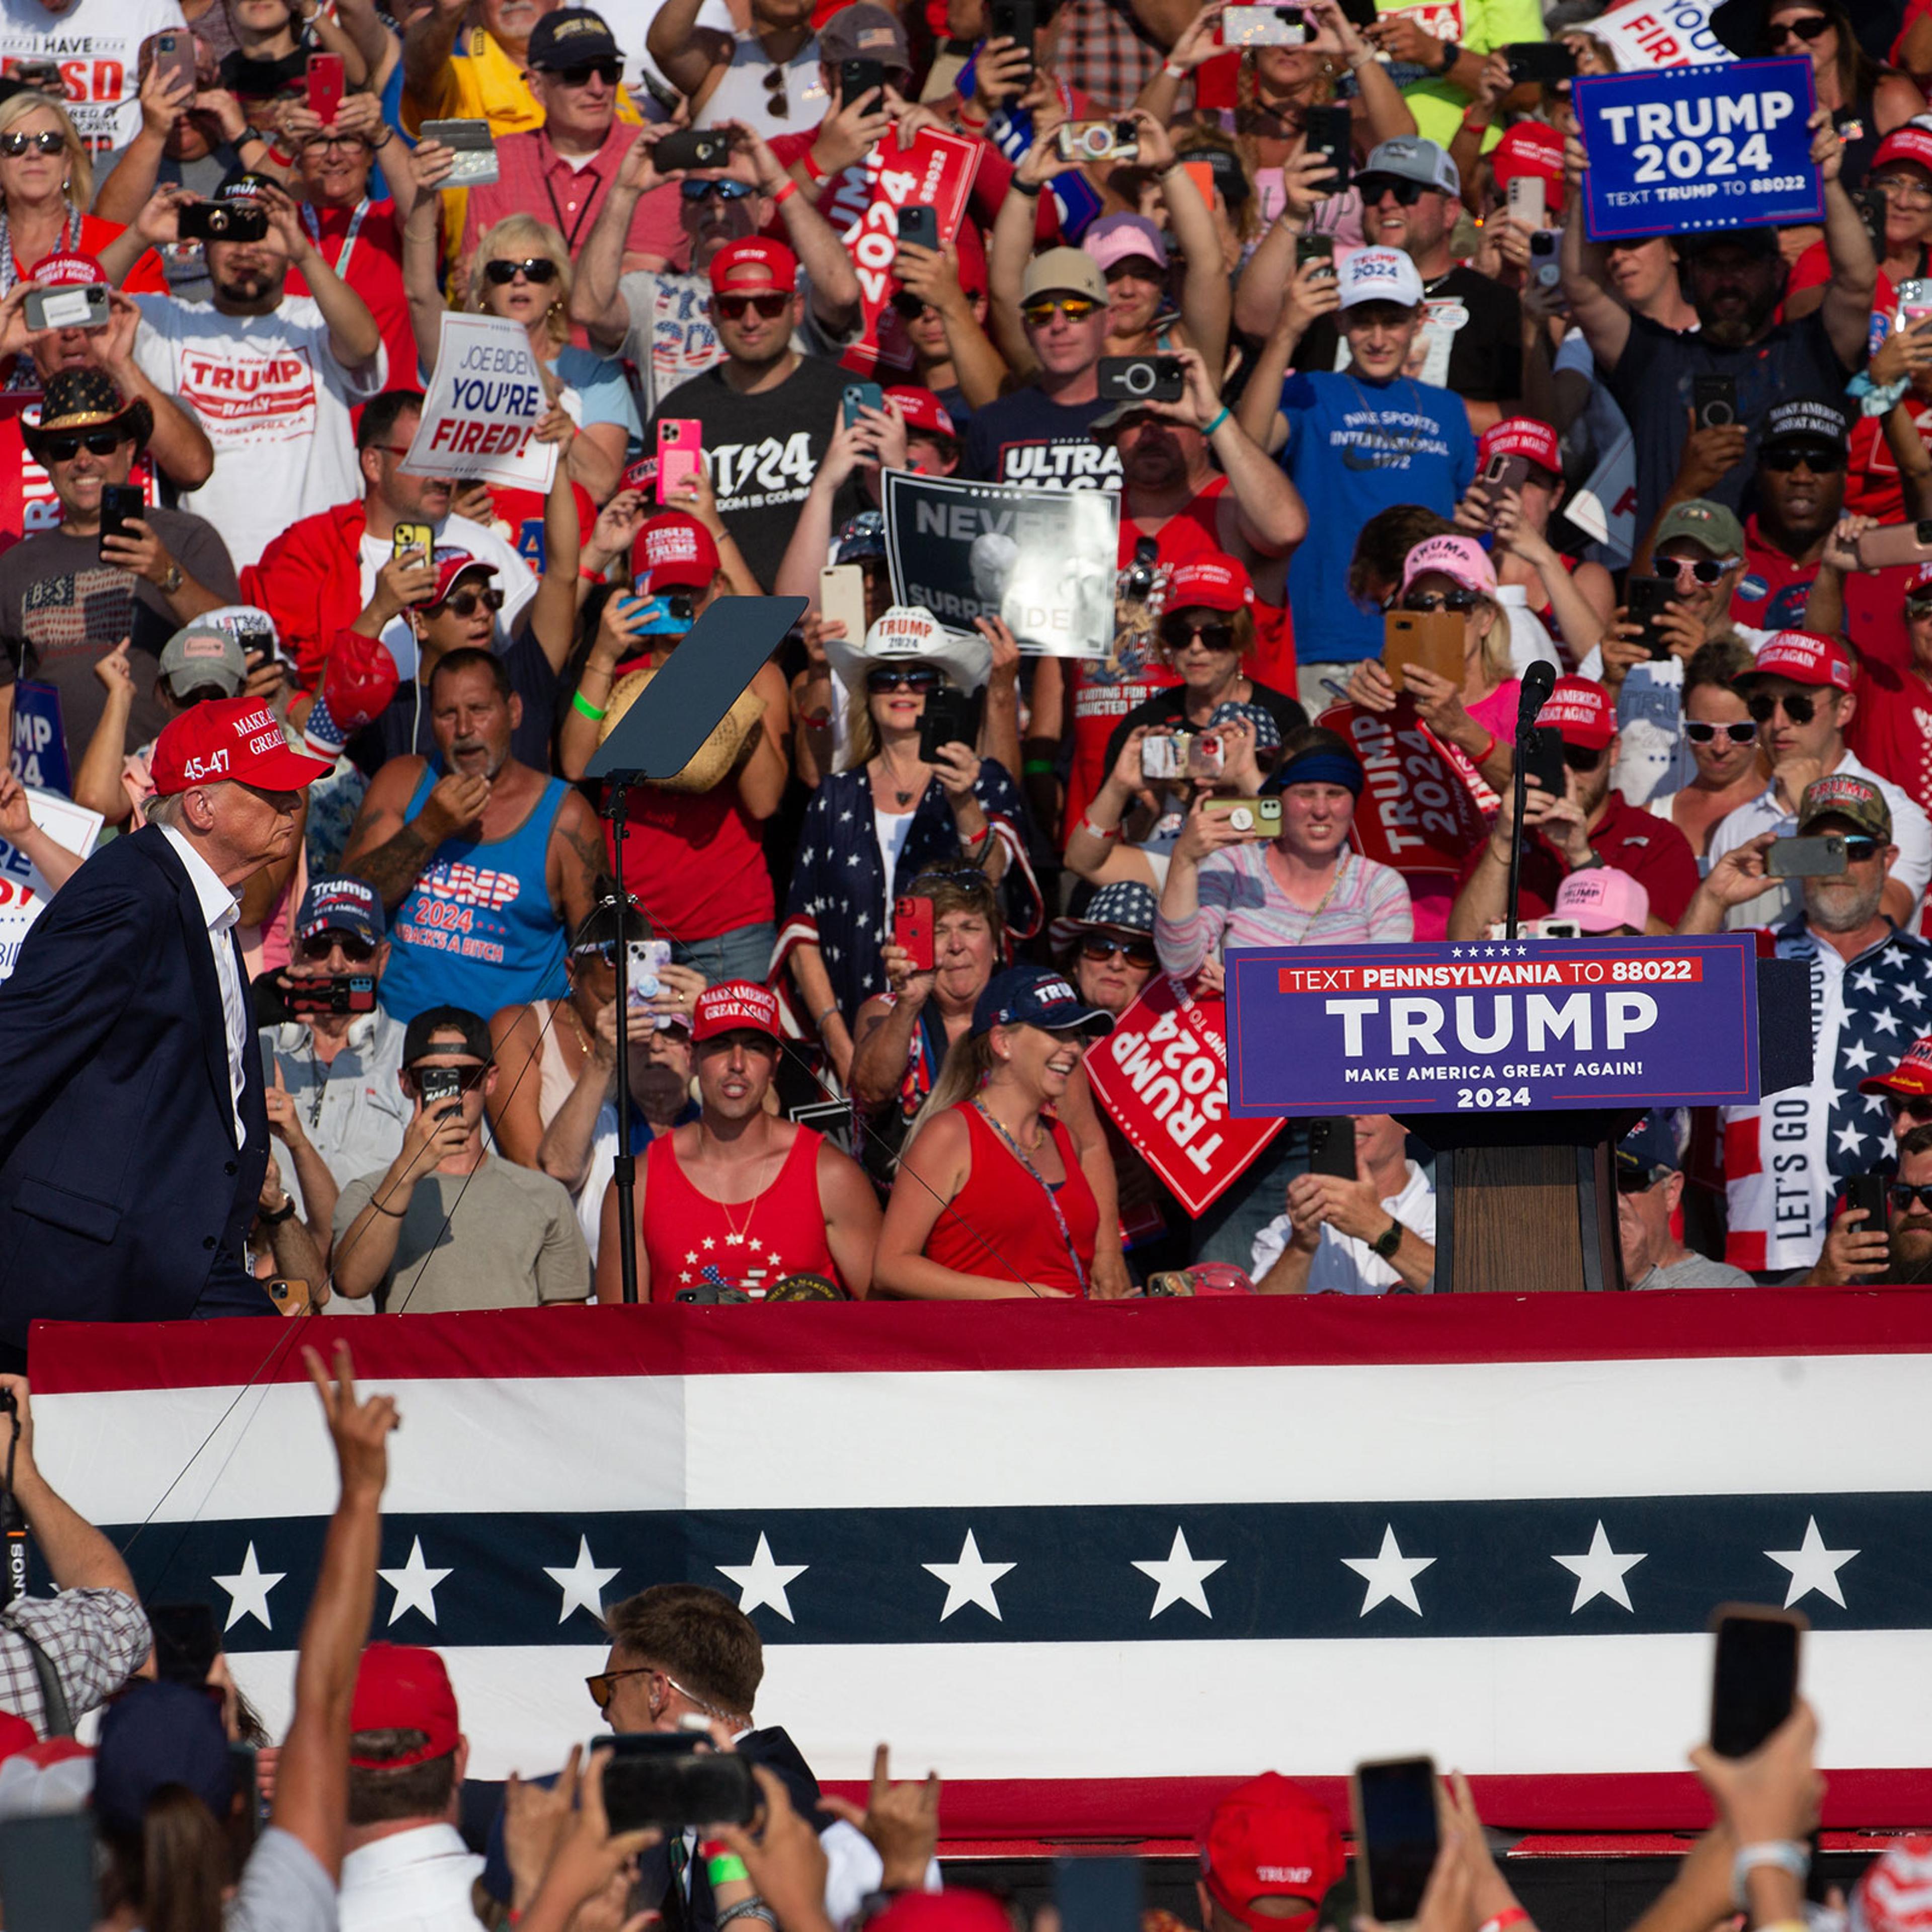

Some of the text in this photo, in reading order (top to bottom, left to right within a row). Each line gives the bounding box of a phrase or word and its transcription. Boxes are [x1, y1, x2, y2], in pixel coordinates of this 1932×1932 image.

[44, 37, 93, 52] HAVE
[1599, 91, 1794, 145] TRUMP
[1632, 133, 1773, 183] 2024
[1605, 175, 1806, 207] TEXT TRUMP TO 88022
[1352, 263, 1398, 281] 2024
[459, 346, 494, 372] JOE
[191, 359, 303, 393] TRUMP
[452, 377, 539, 417] YOU'RE
[1343, 411, 1440, 436] NIKE SPORTS
[1801, 401, 1846, 427] AMERICA
[429, 418, 534, 458] FIRED!
[1809, 417, 1840, 438] AGAIN
[1005, 444, 1124, 478] ULTRA
[647, 544, 697, 559] TRUMP
[877, 617, 932, 638] TRUMP
[1775, 632, 1826, 657] AMERICA
[1781, 649, 1817, 669] AGAIN
[1554, 688, 1603, 710] AMERICA
[232, 709, 267, 738] MAKE
[1563, 706, 1596, 725] AGAIN
[183, 748, 230, 780] 45-47
[1350, 714, 1426, 855] TRUMP
[1397, 730, 1459, 837] 2024
[1808, 778, 1875, 803] TRUMP
[311, 880, 373, 902] Trump
[415, 896, 474, 934] 2024
[446, 934, 460, 953] A
[461, 936, 505, 964] BITCH
[1290, 960, 1692, 990] TEXT PENNSYLVANIA TO 88022
[699, 985, 776, 1013] MAKE AMERICA
[1033, 981, 1078, 1003] TRU
[705, 1001, 741, 1021] GREAT
[1188, 1009, 1208, 1033] TO
[1325, 991, 1658, 1057] TRUMP
[1147, 1010, 1228, 1121] 2024
[1345, 1062, 1642, 1082] MAKE AMERICA GREAT AGAIN!
[1110, 1031, 1224, 1176] TRUMP
[1457, 1087, 1532, 1108] 2024
[1772, 1098, 1812, 1242] LET'S GO
[1257, 1867, 1312, 1884] TRUMP
